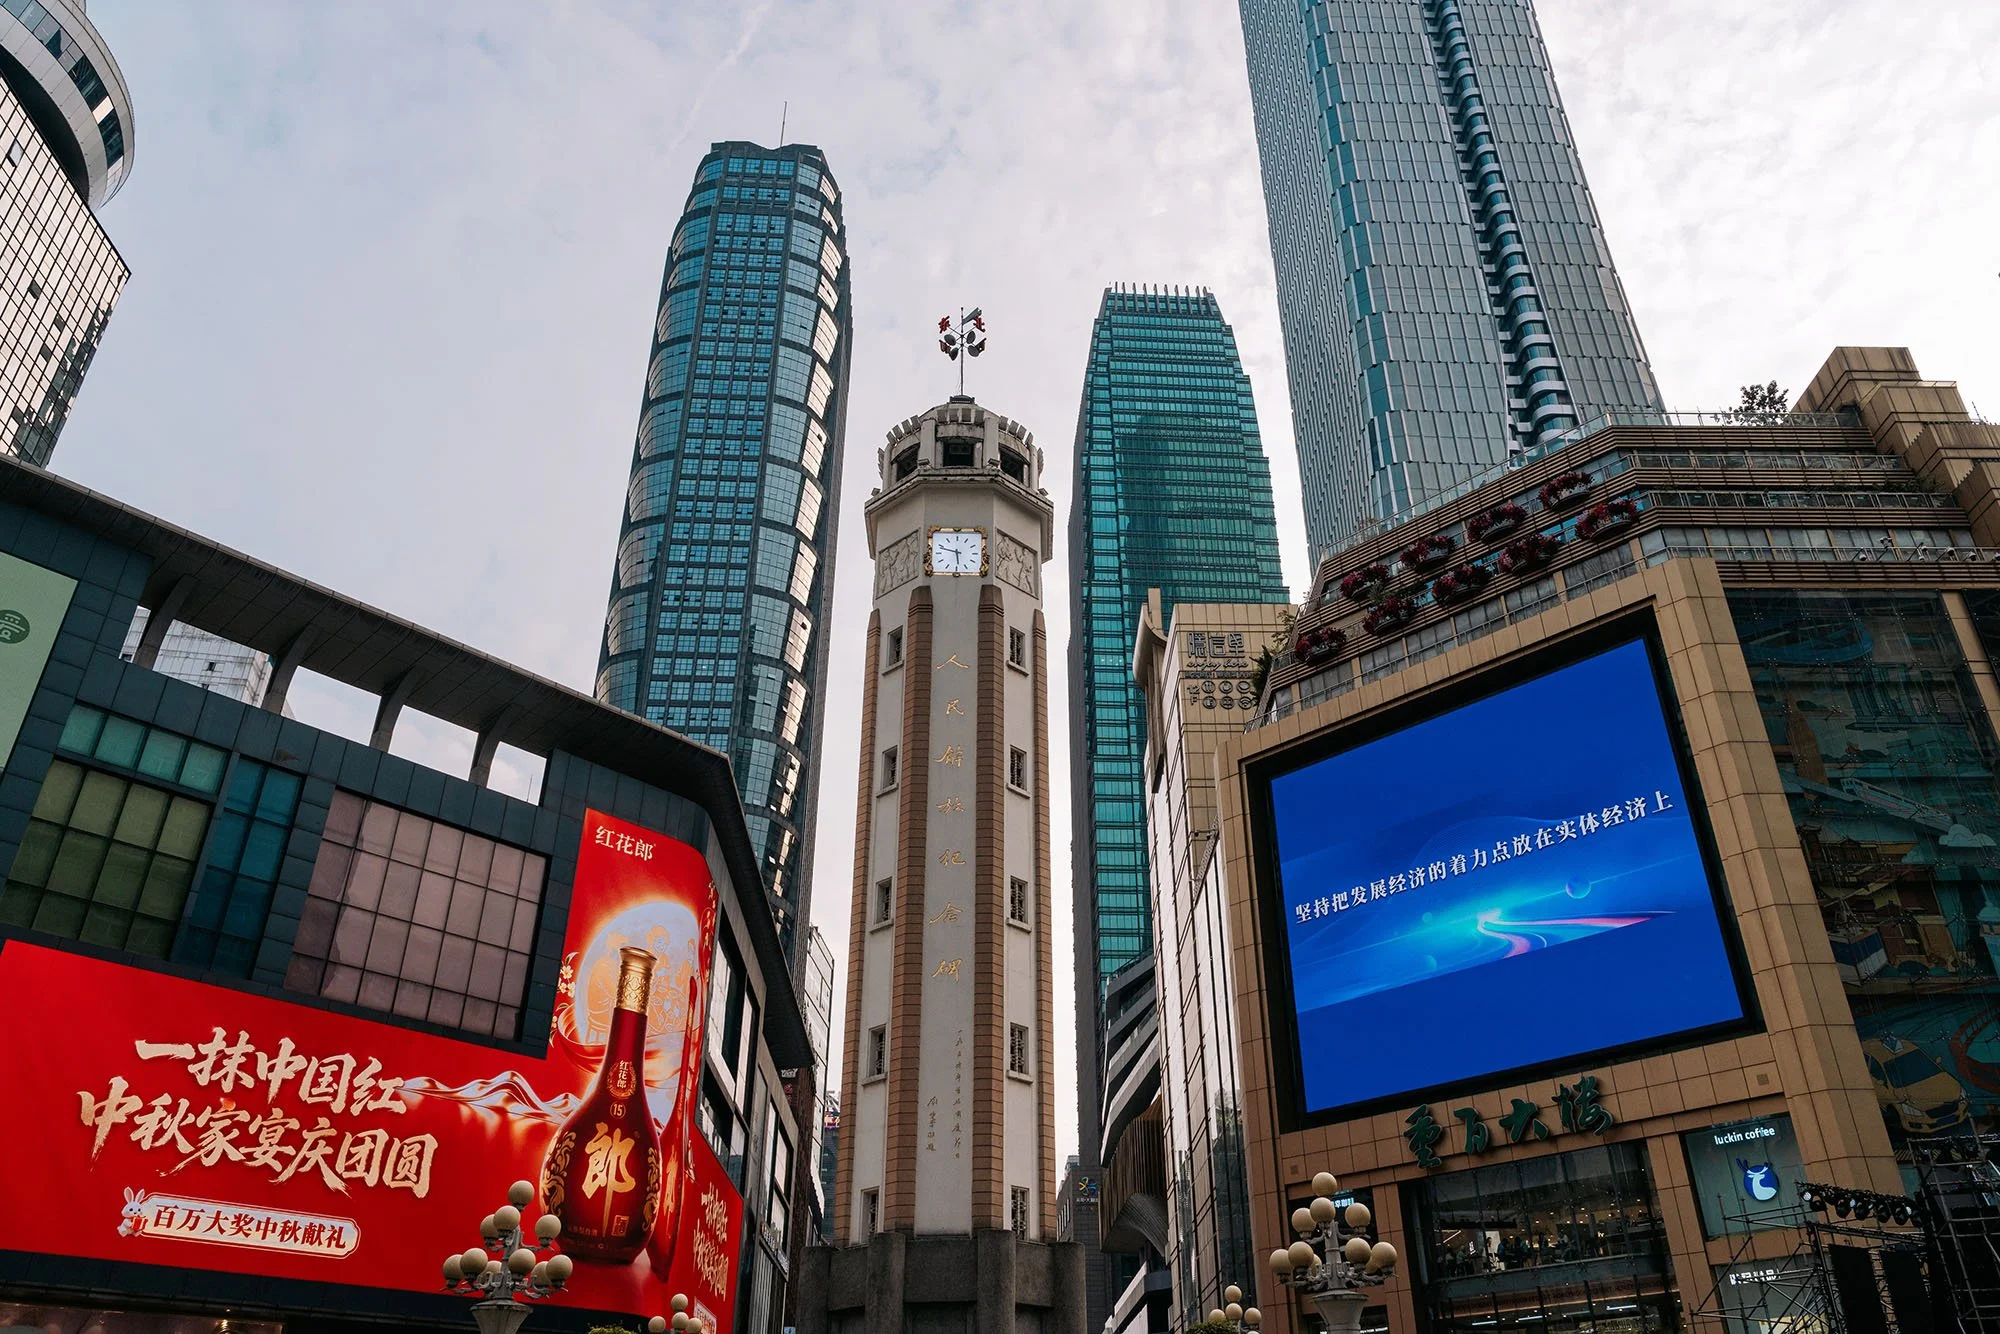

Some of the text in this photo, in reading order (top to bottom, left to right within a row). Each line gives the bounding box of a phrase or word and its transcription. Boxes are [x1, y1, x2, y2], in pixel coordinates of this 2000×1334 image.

[594, 825, 654, 862] 红花郎
[1294, 790, 1674, 924] 坚持把发展经济的着力点放在实体经济上
[134, 1026, 408, 1117] 一抹中国红
[78, 1075, 438, 1199] 中秋家宴庆团圆
[613, 1104, 623, 1117] 15
[1714, 1127, 1775, 1145] luckin coffee
[582, 1121, 636, 1238] 郎
[153, 1204, 347, 1249] 百万大奖中秋献礼
